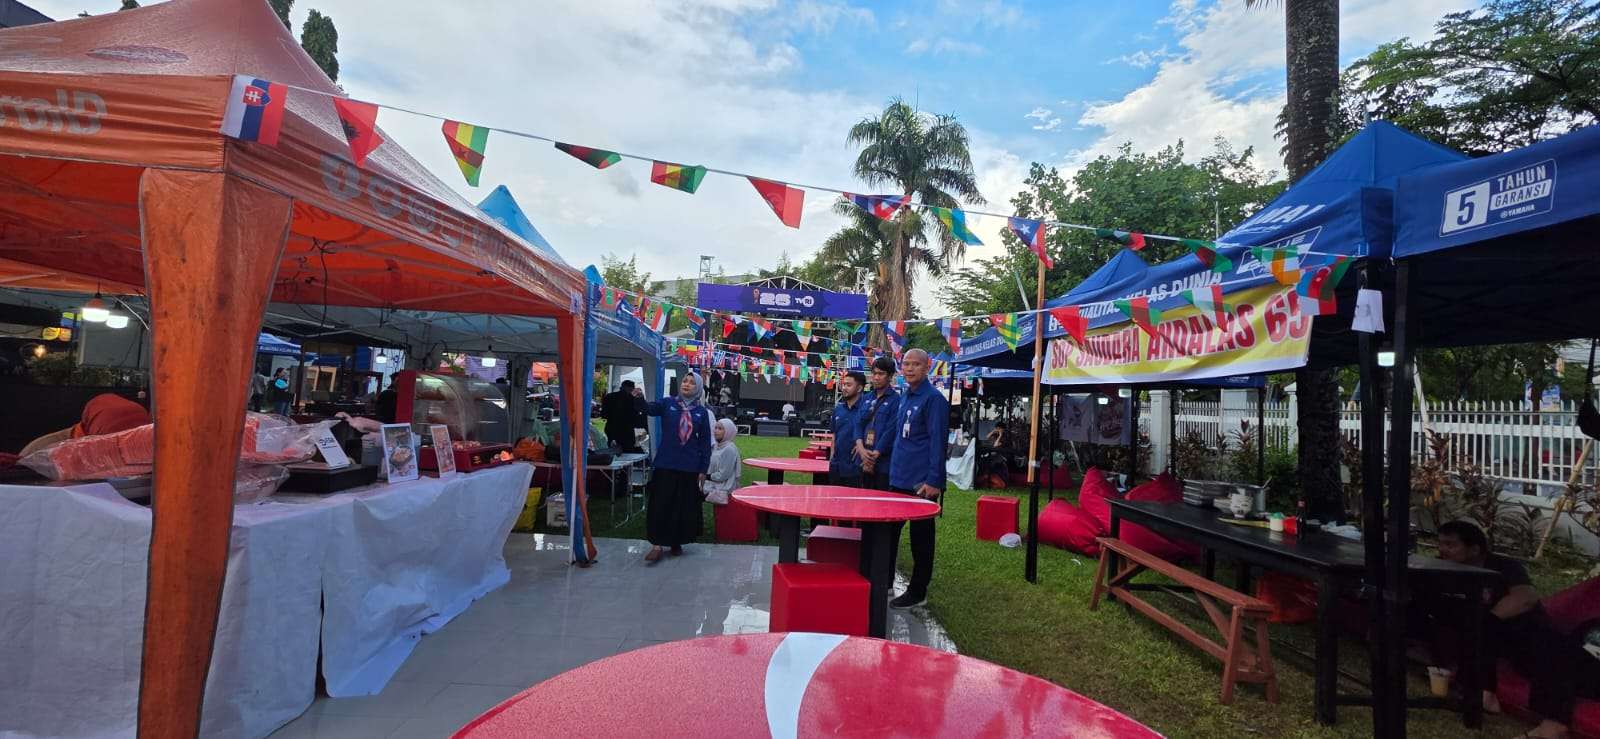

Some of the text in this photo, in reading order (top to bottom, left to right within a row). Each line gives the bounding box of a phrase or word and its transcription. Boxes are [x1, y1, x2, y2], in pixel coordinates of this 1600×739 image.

[1497, 165, 1547, 192] TAHUN
[1456, 190, 1477, 226] 5
[1495, 182, 1547, 208] GARANSI
[1507, 204, 1536, 217] YAMAHA
[1171, 270, 1223, 297] DUNIA
[1147, 303, 1257, 362] ANDALAS
[1263, 288, 1309, 344] 65
